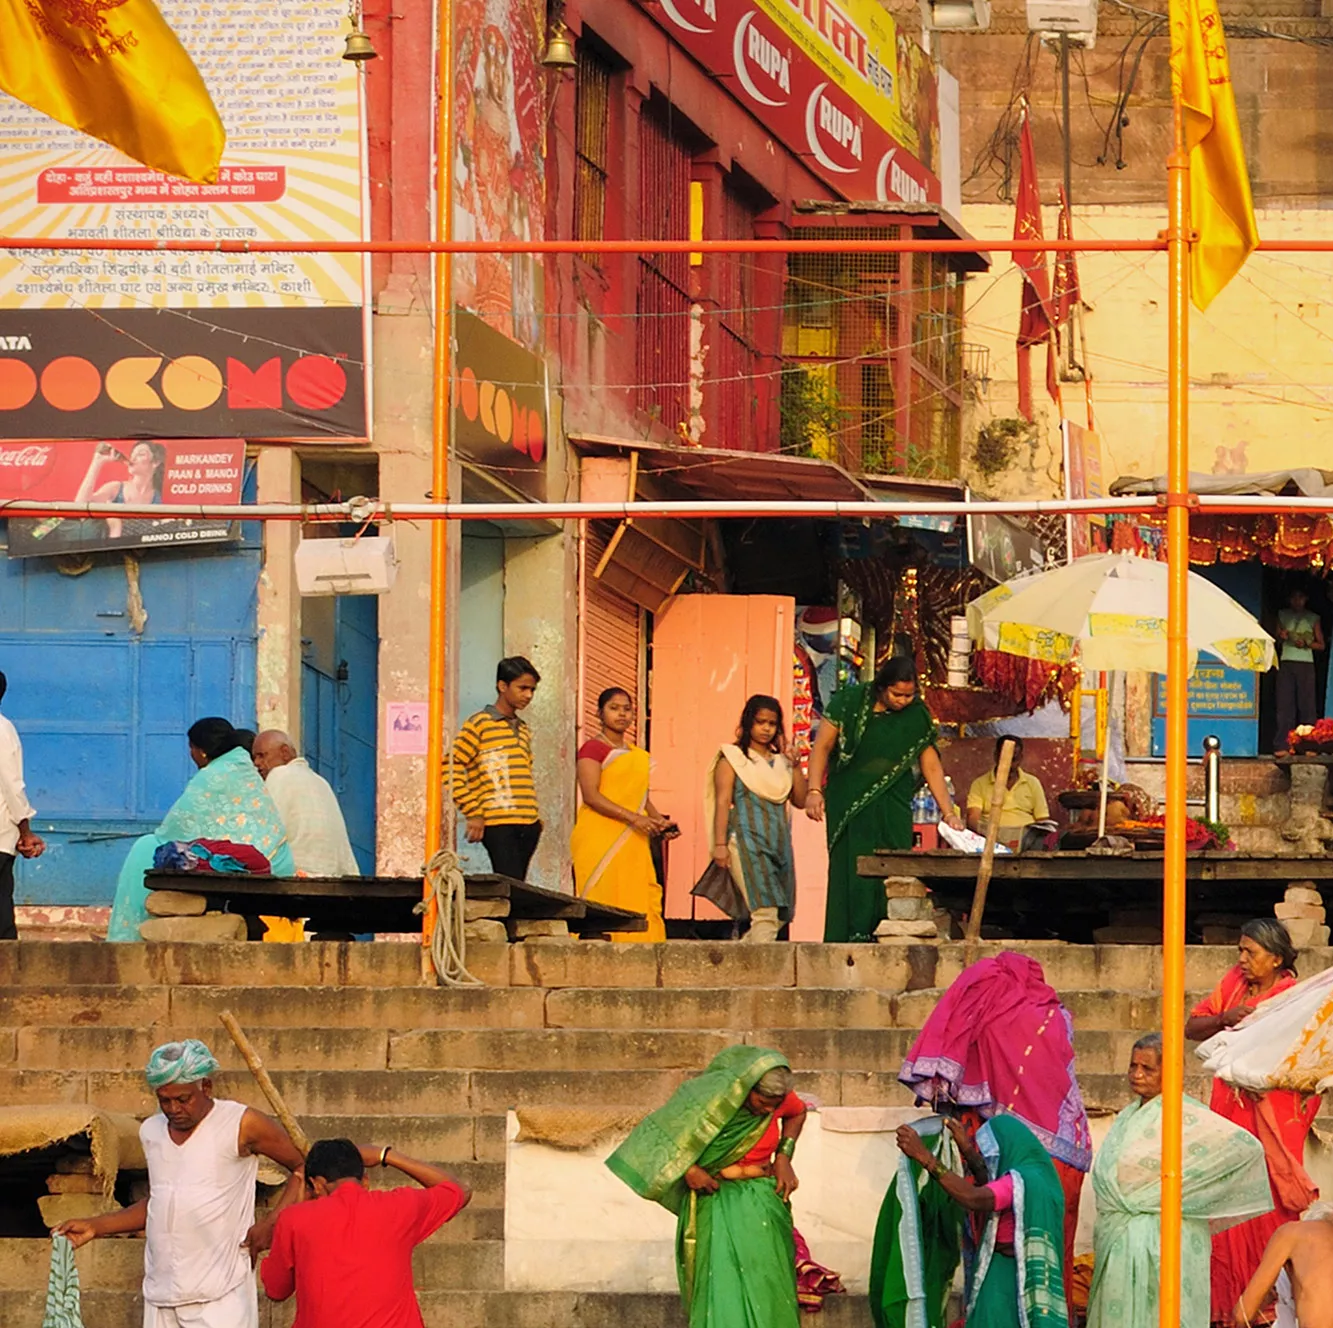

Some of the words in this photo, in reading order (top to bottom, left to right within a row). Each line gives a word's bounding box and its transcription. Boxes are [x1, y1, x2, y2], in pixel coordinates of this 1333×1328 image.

[749, 22, 791, 95] RUPA
[820, 94, 863, 162] RUPA
[68, 225, 108, 238] भगवती
[113, 225, 151, 238] शीतला
[216, 227, 257, 237] उपासक
[281, 279, 311, 292] काशी
[0, 336, 32, 350] ATA
[175, 453, 233, 465] MARKANDEY
[168, 469, 194, 479] PAAN
[195, 469, 202, 479] &
[205, 468, 239, 479] MANOJ
[171, 483, 197, 495] COLD
[198, 482, 233, 494] DRINKS
[142, 532, 173, 543] MANOJ
[175, 530, 199, 540] COLD
[200, 528, 228, 538] DRINK
